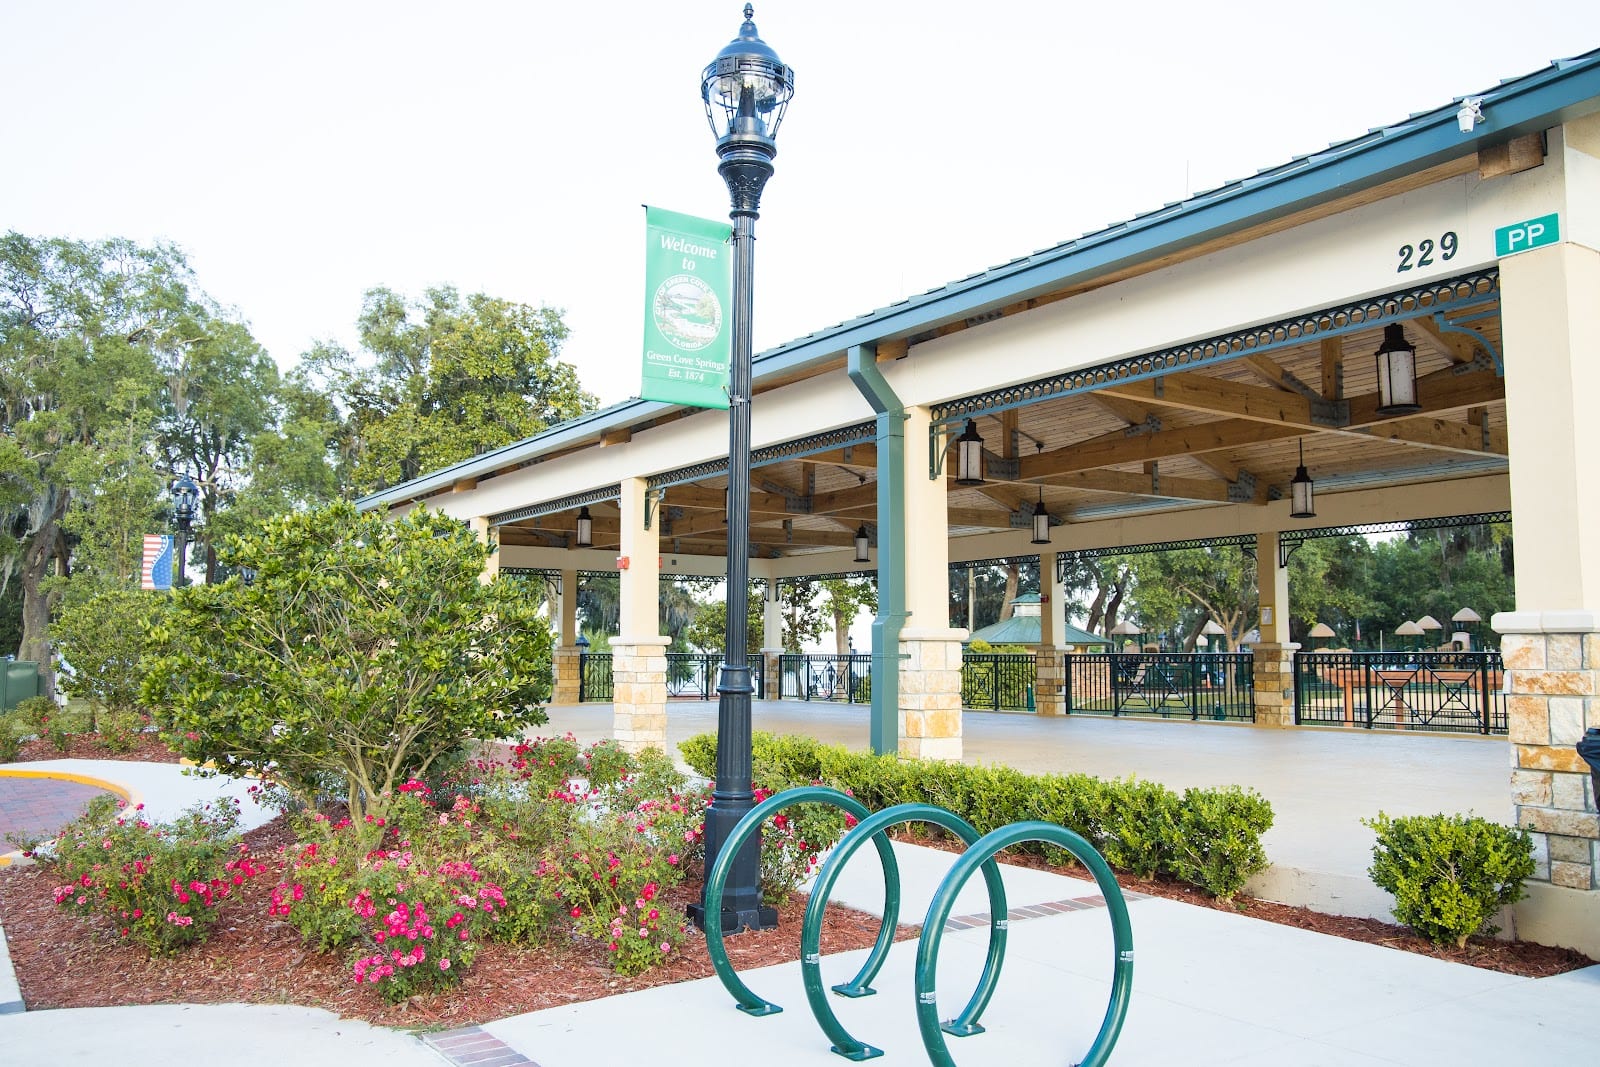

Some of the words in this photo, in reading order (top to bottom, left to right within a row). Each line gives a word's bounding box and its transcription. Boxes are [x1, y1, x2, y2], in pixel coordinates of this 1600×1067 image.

[1508, 223, 1545, 251] PP
[660, 235, 717, 259] Welcome
[1396, 231, 1459, 273] 229
[682, 257, 696, 271] to
[672, 337, 703, 349] FLORIDA
[647, 351, 672, 362] Green
[673, 353, 694, 366] Cove
[695, 358, 725, 370] Springs
[668, 368, 682, 379] Est.
[685, 370, 705, 382] 1874
